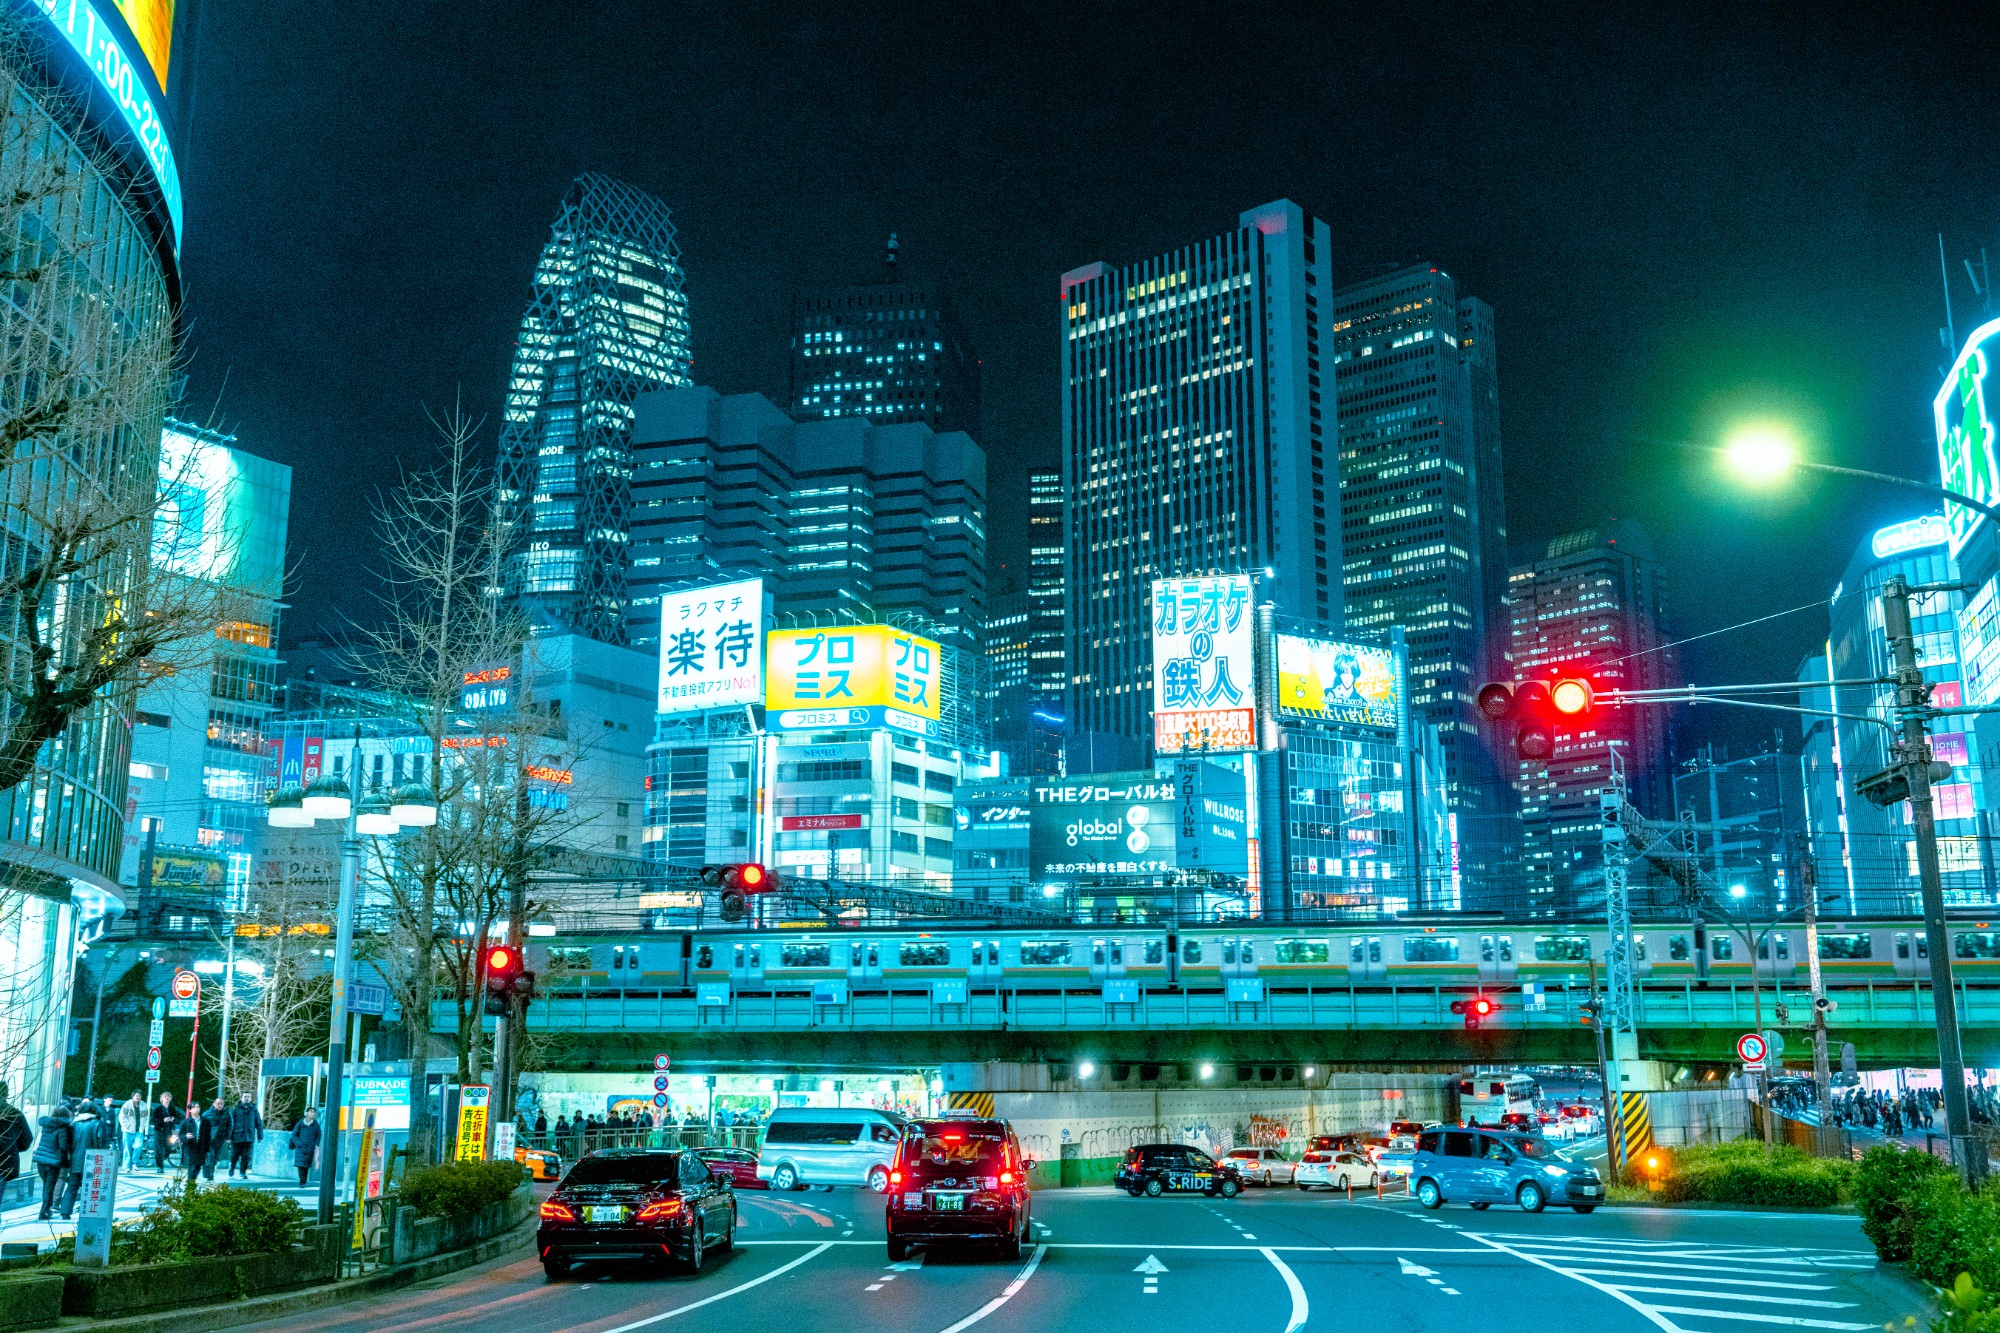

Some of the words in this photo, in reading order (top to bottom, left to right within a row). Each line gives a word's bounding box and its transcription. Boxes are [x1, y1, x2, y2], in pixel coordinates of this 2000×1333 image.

[539, 446, 565, 456] MODE
[533, 494, 553, 504] HAL
[1875, 523, 1945, 552] welcia
[680, 596, 744, 620] ラクマチ
[1154, 577, 1250, 637] カラオケ
[667, 619, 755, 677] 楽待
[794, 632, 855, 666] プロ
[1190, 628, 1214, 662] の
[662, 678, 732, 700] 不動産投資アプリ
[733, 674, 757, 691] No.1
[794, 669, 854, 699] ミス
[1161, 655, 1243, 708] 鉄人
[797, 712, 838, 725] プロミス
[895, 713, 920, 730] プロミス
[1322, 704, 1397, 728] たいせい先生
[1177, 764, 1198, 773] THE
[1036, 784, 1176, 803] THEグローバル社
[981, 806, 1031, 821] インター
[1182, 774, 1196, 838] グローバル社
[1204, 798, 1245, 824] WILLROSE
[1066, 817, 1122, 847] global
[158, 861, 203, 885] Jungle
[1045, 860, 1172, 874] 未来の不動産を面白くする。
[355, 1080, 407, 1089] SUBNADE
[1168, 1177, 1213, 1190] S.RIDE
